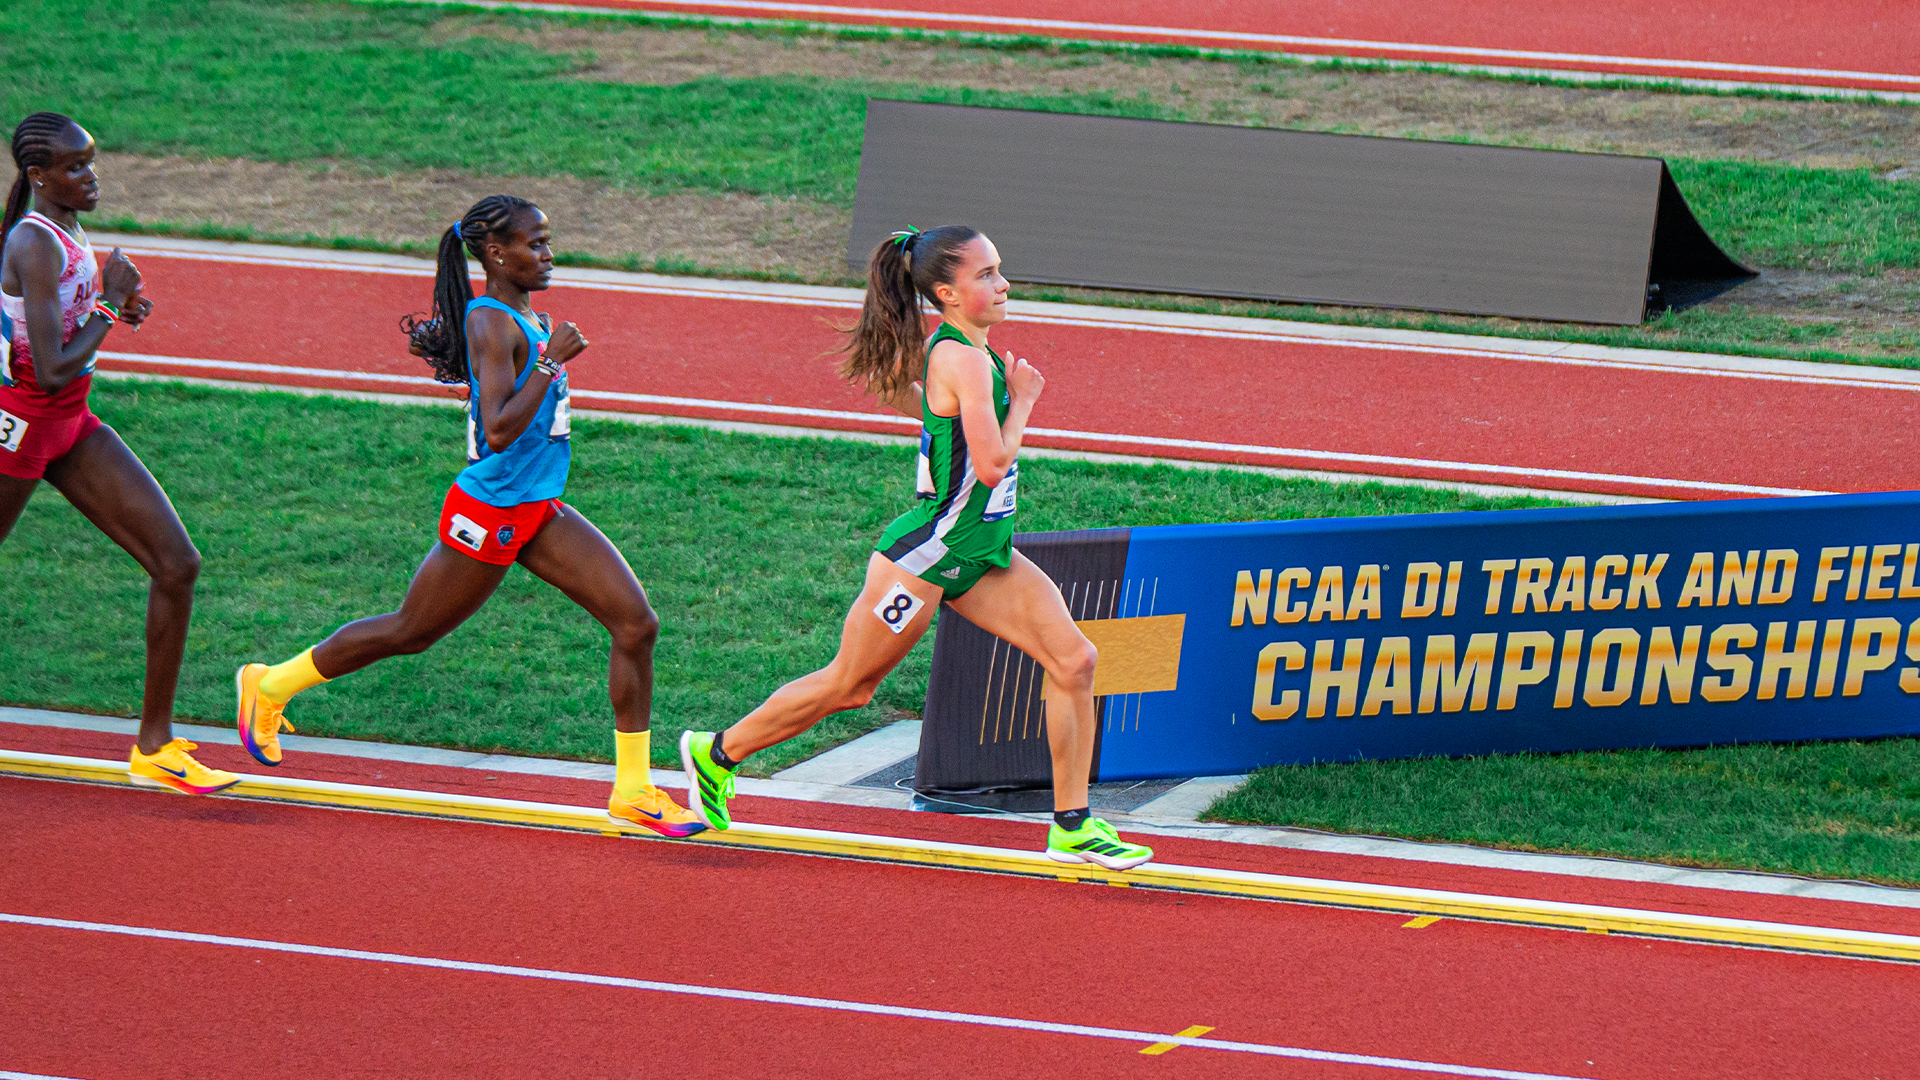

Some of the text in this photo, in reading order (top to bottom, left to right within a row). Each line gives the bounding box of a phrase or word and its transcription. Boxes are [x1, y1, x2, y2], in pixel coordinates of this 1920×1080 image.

[0, 411, 17, 445] 3
[1401, 560, 1463, 618] DI
[1482, 553, 1670, 615] TRACK
[1676, 548, 1799, 608] AND
[882, 593, 913, 624] 8
